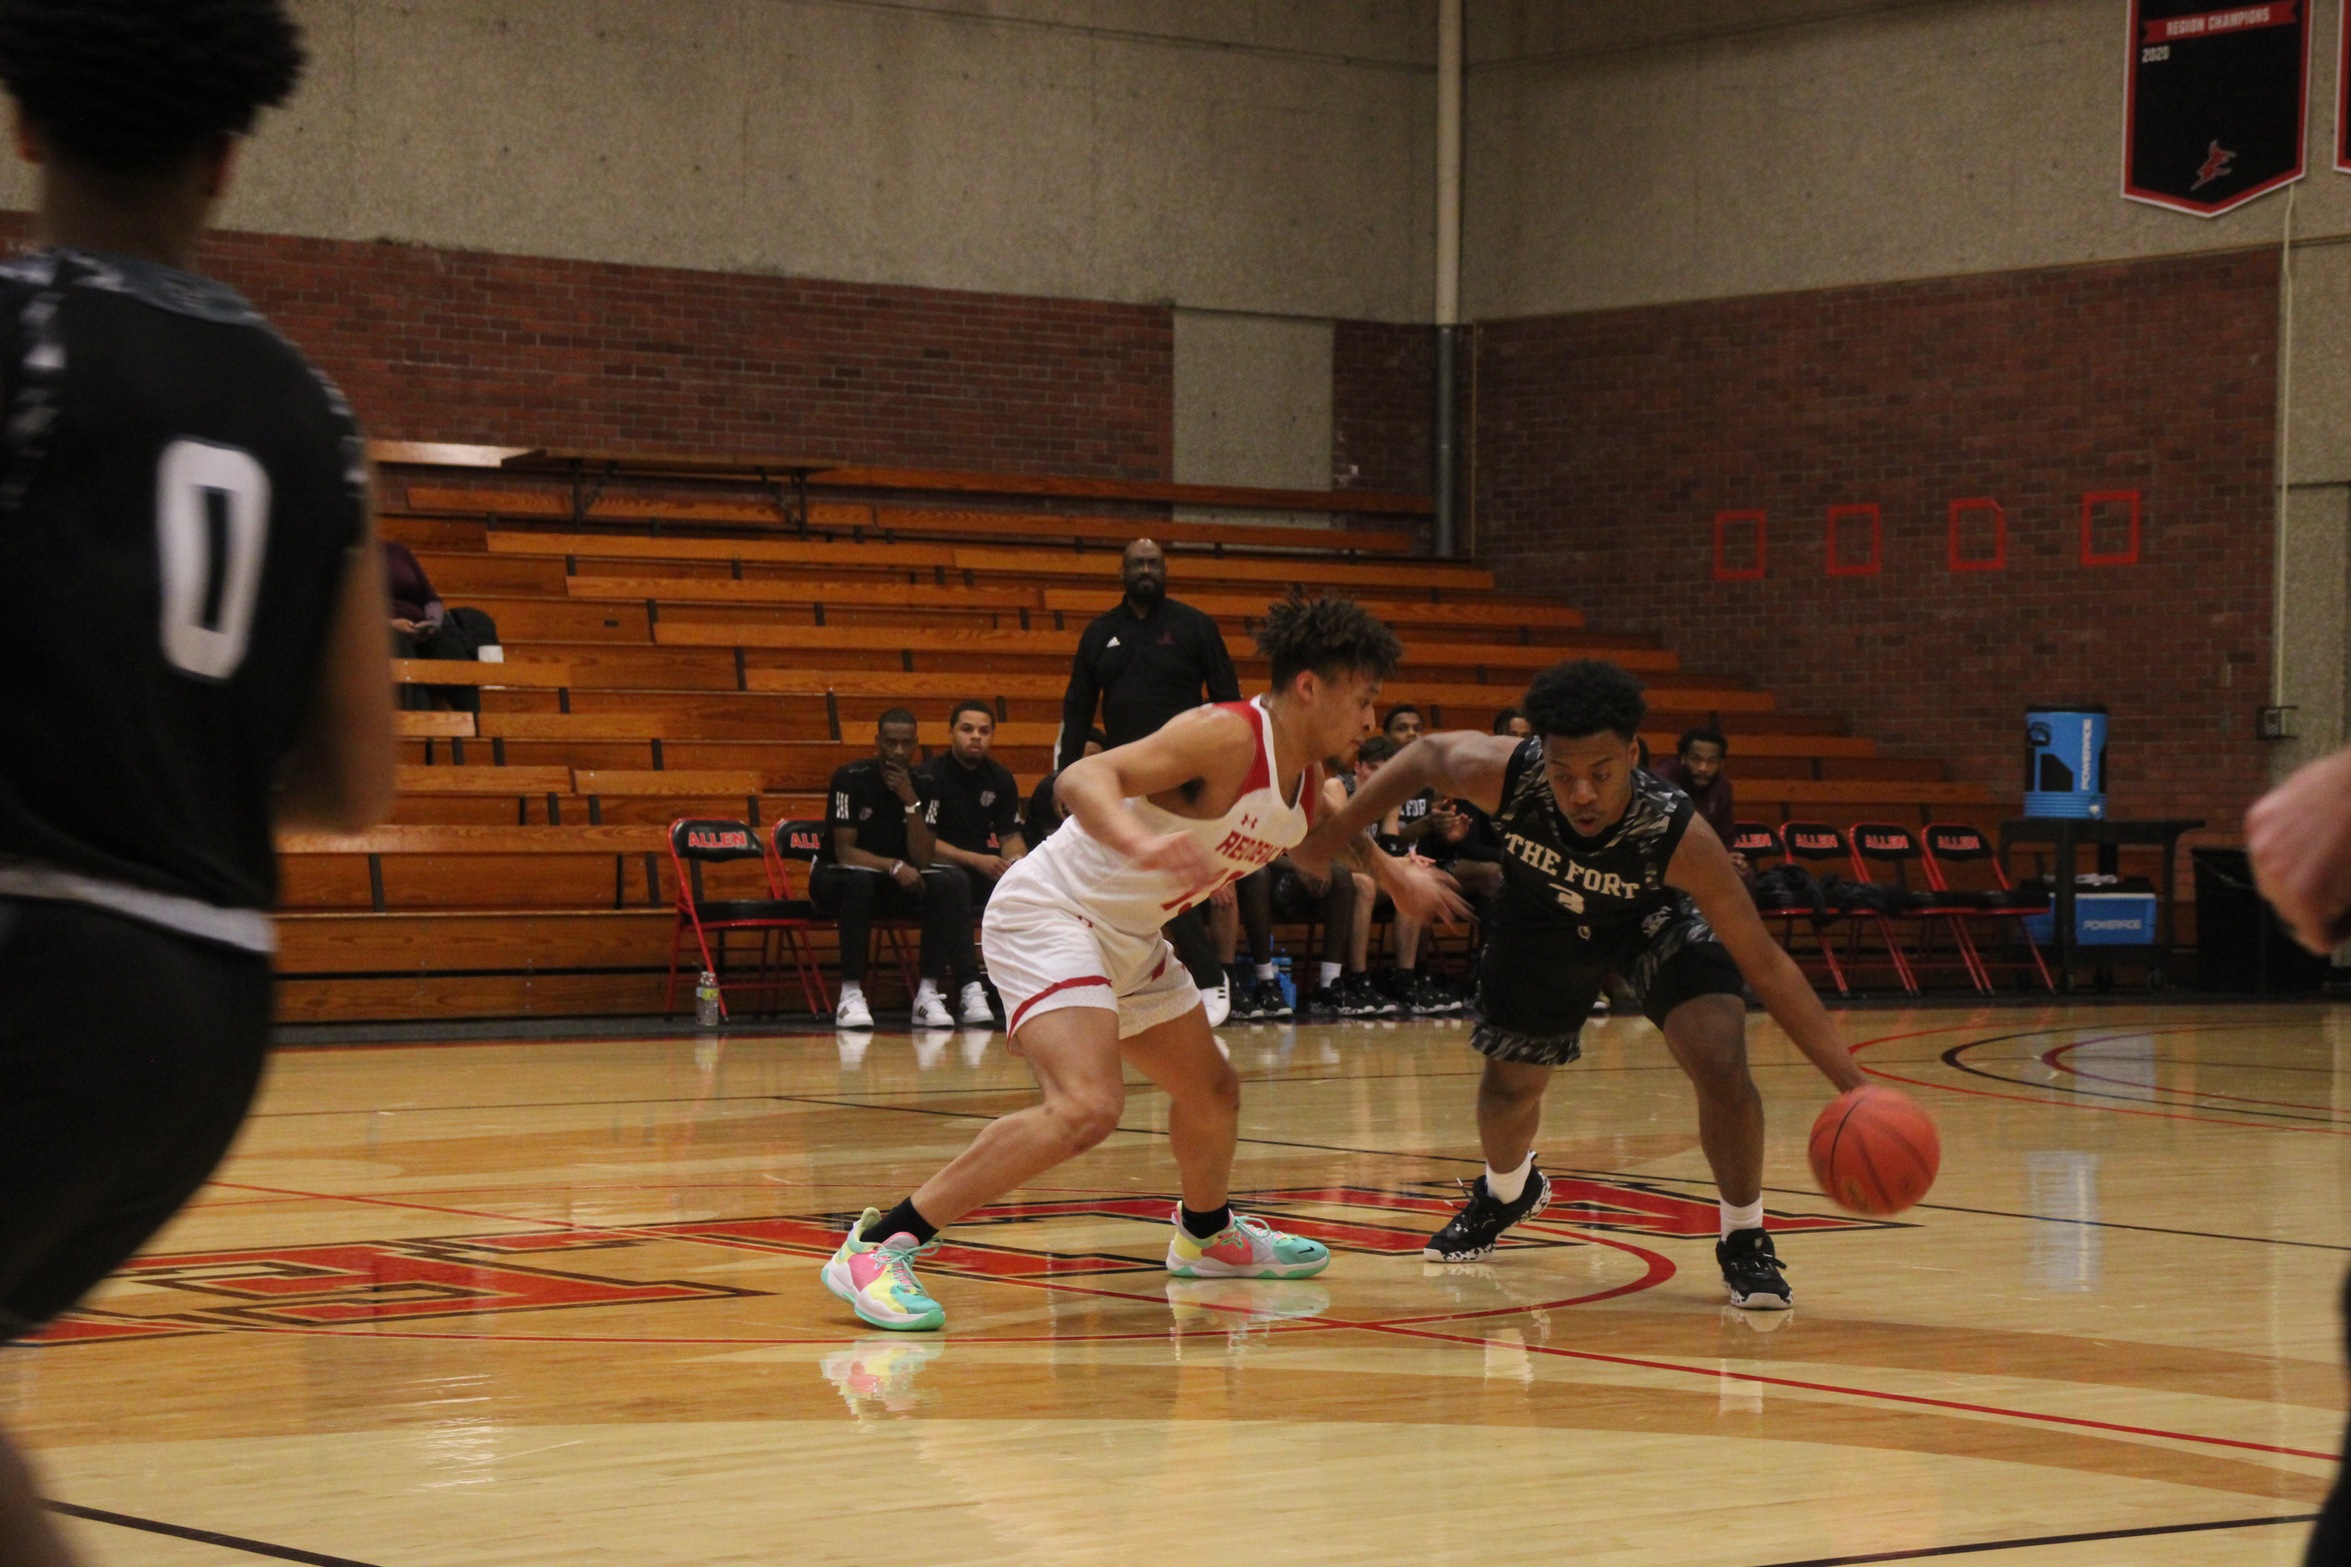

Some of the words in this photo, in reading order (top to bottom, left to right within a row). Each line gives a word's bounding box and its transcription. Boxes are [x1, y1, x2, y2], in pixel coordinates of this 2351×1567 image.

[2166, 17, 2204, 36] REGION
[2208, 7, 2270, 31] CHAMPIONS
[156, 438, 271, 682] 0
[2081, 718, 2092, 791] POWERADE
[689, 831, 747, 849] ALLEN
[790, 832, 820, 849] ALL
[1795, 833, 1839, 849] ALLEN
[1865, 834, 1909, 850] ALLEN
[1937, 835, 1981, 850] ALLEN
[1504, 832, 1562, 876] THE
[1564, 859, 1640, 899] FORT
